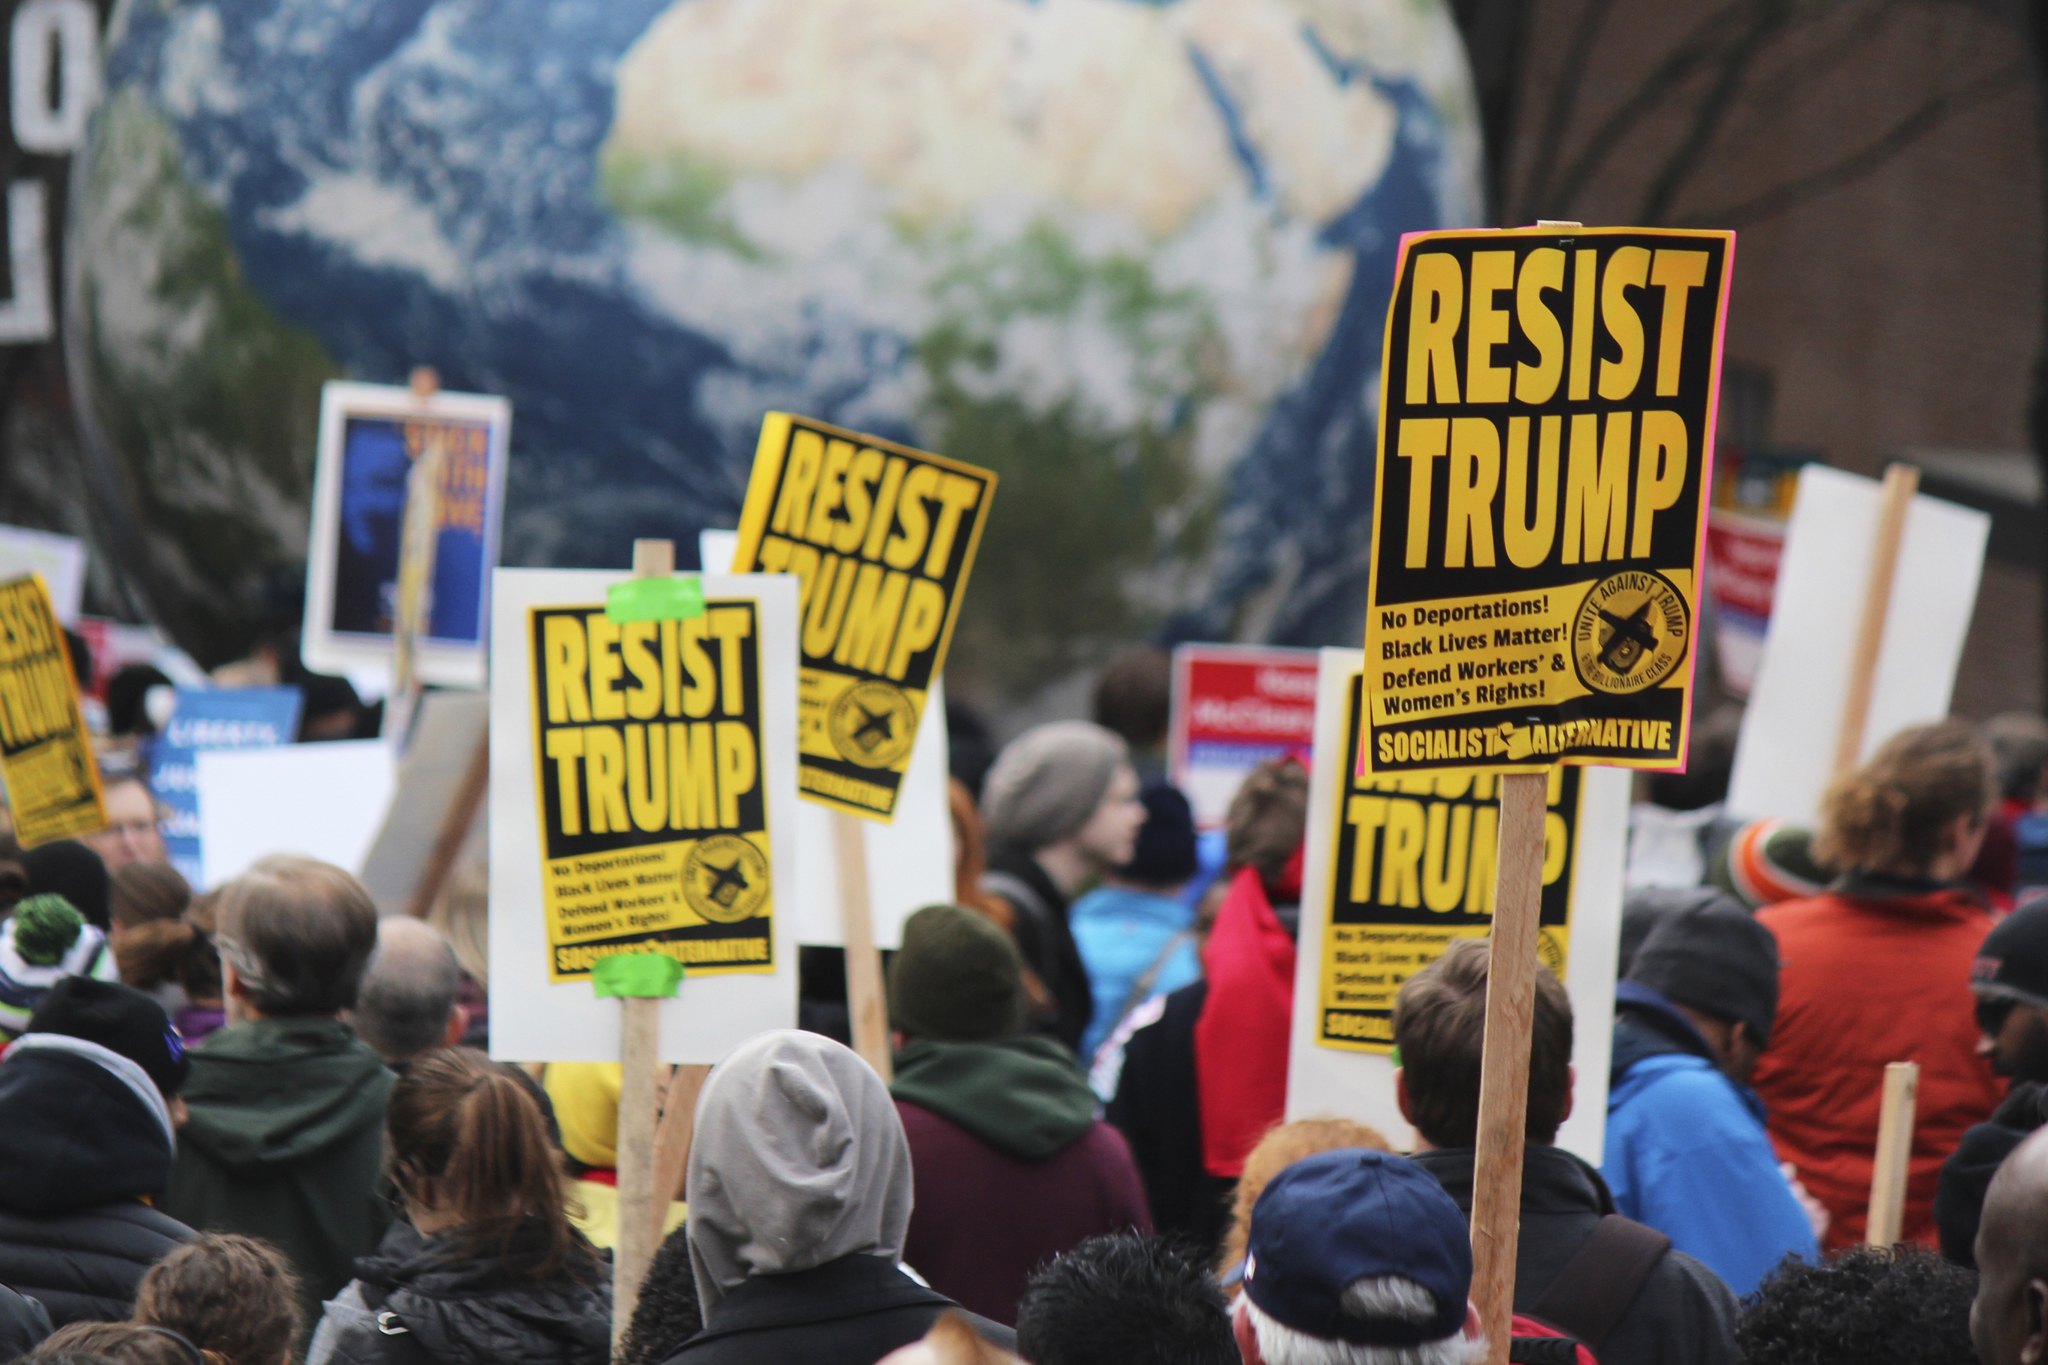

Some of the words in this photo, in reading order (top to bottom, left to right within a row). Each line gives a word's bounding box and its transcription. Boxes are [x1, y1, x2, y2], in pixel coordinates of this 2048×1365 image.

[1405, 246, 1709, 405] RESIST
[771, 428, 982, 580] RESIST
[1397, 410, 1689, 569] TRUMP
[1382, 611, 1408, 630] No
[1413, 595, 1549, 627] Deportations!
[1578, 597, 1601, 642] UNITE
[1600, 573, 1658, 601] AGAINST
[1655, 586, 1683, 637] TRUMP
[544, 608, 752, 722] RESIST
[1382, 637, 1433, 660] Black
[1439, 633, 1488, 653] Lives
[1493, 623, 1568, 648] Matter!
[1645, 653, 1672, 680] CLASS
[1383, 664, 1451, 690] Defend
[1551, 653, 1566, 672] &
[1383, 688, 1471, 716] Women's
[1476, 680, 1546, 705] Rights!
[1378, 728, 1498, 763] SOCIALIST
[546, 721, 757, 836] TRUMP
